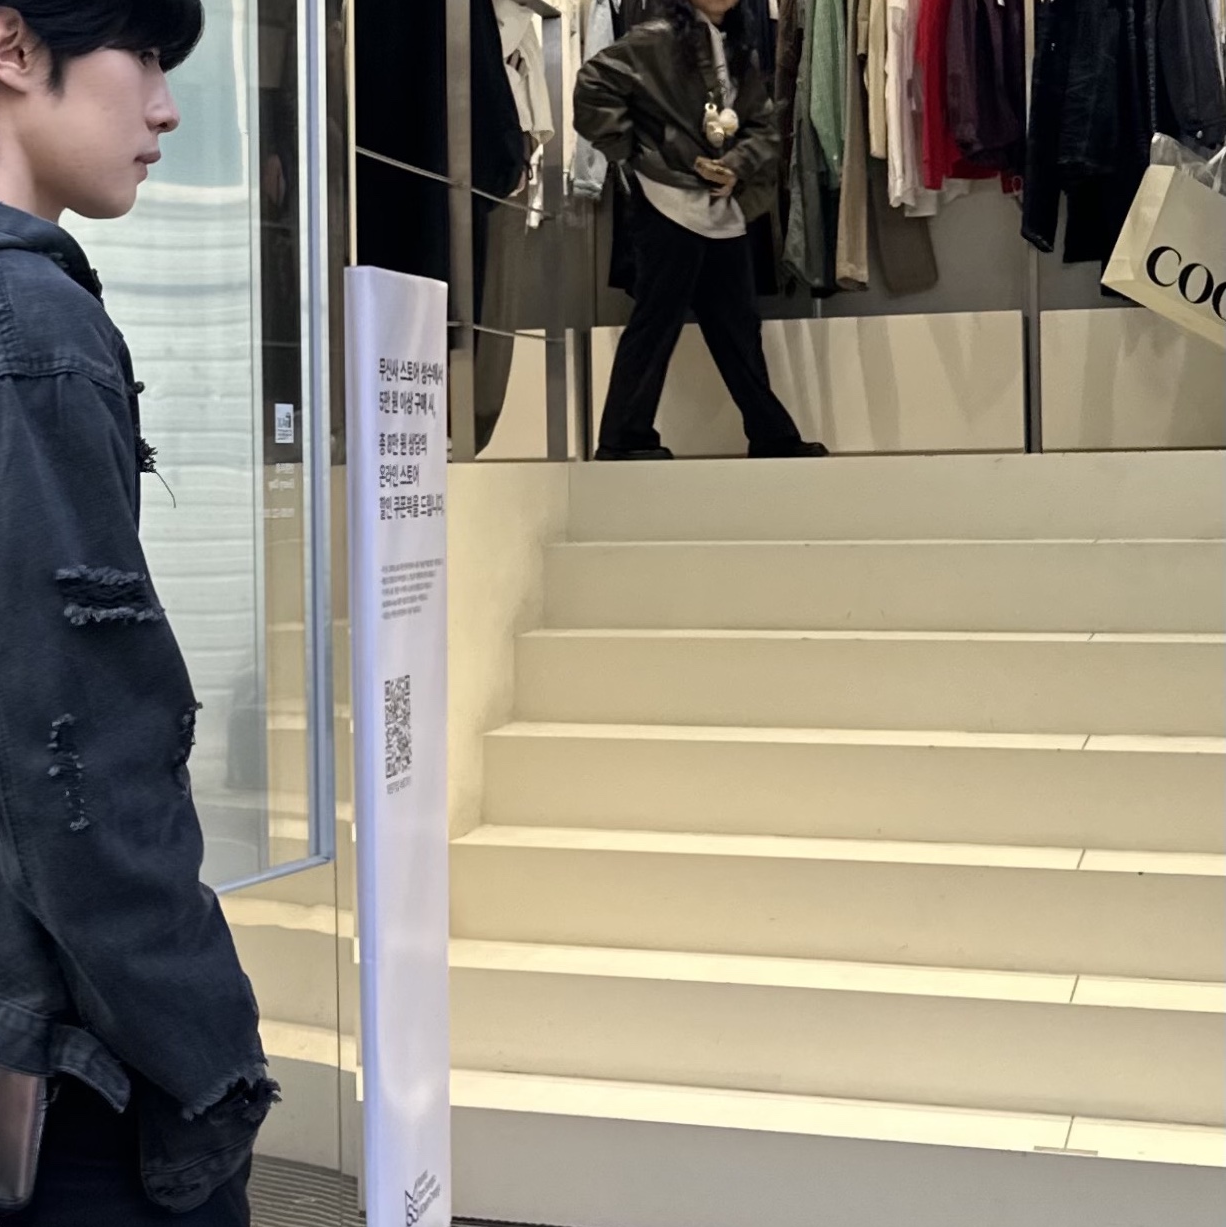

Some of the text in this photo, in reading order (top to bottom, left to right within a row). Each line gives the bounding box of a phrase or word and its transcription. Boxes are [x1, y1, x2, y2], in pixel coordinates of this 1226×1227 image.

[379, 357, 398, 382] 무신사
[400, 360, 420, 385] 스토어
[400, 390, 413, 415] 이상
[414, 392, 427, 415] 구매
[379, 463, 420, 488] 온라인 스토어
